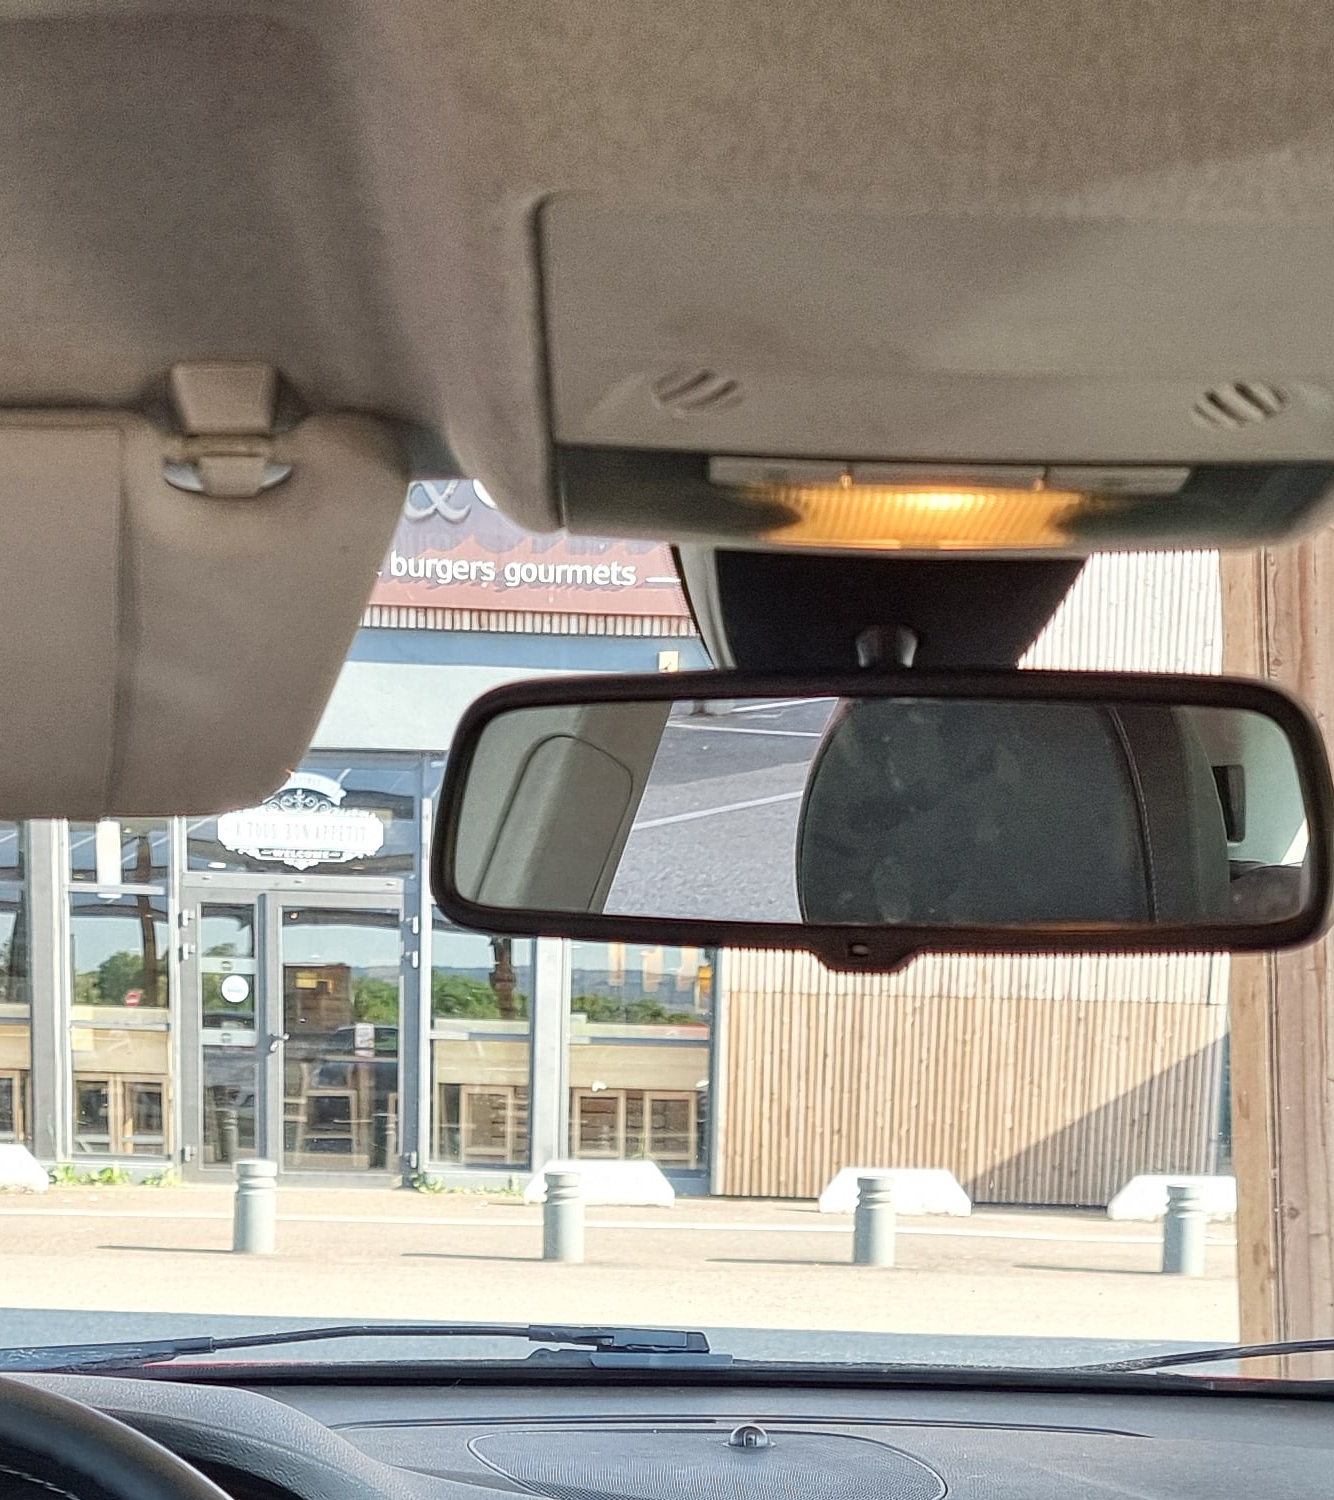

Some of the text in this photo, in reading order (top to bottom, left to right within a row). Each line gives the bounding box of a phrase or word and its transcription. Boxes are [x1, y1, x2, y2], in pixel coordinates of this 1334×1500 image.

[390, 550, 637, 588] burgers gourmets
[272, 849, 330, 860] WELCOME
